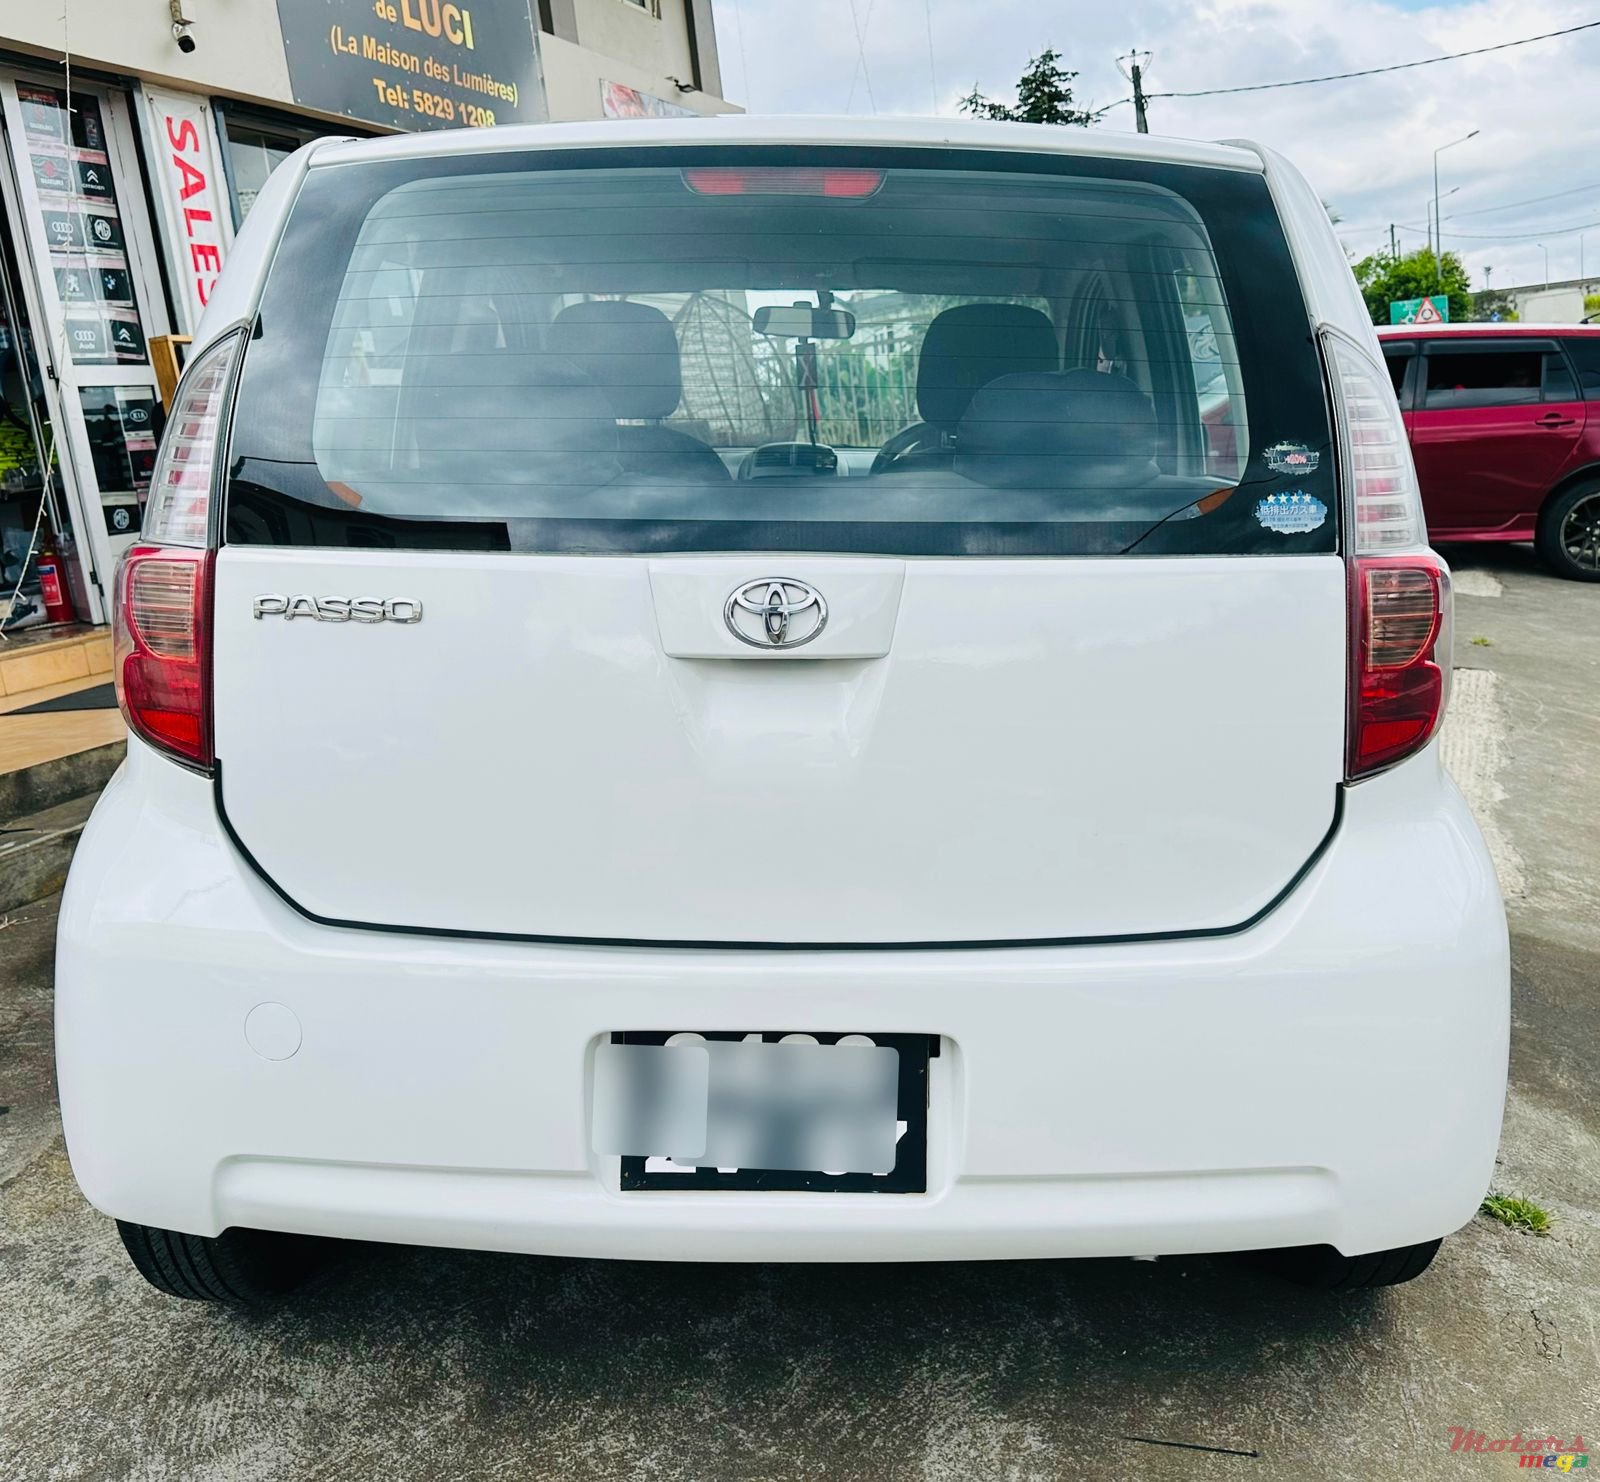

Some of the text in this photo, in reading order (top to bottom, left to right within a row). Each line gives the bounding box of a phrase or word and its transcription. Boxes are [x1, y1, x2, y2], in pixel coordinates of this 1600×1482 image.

[376, 0, 475, 50] de LUCI
[330, 25, 518, 108] (La Maison des Lumières)
[373, 78, 497, 127] Tel: 5829 1208
[254, 593, 423, 623] PASSO
